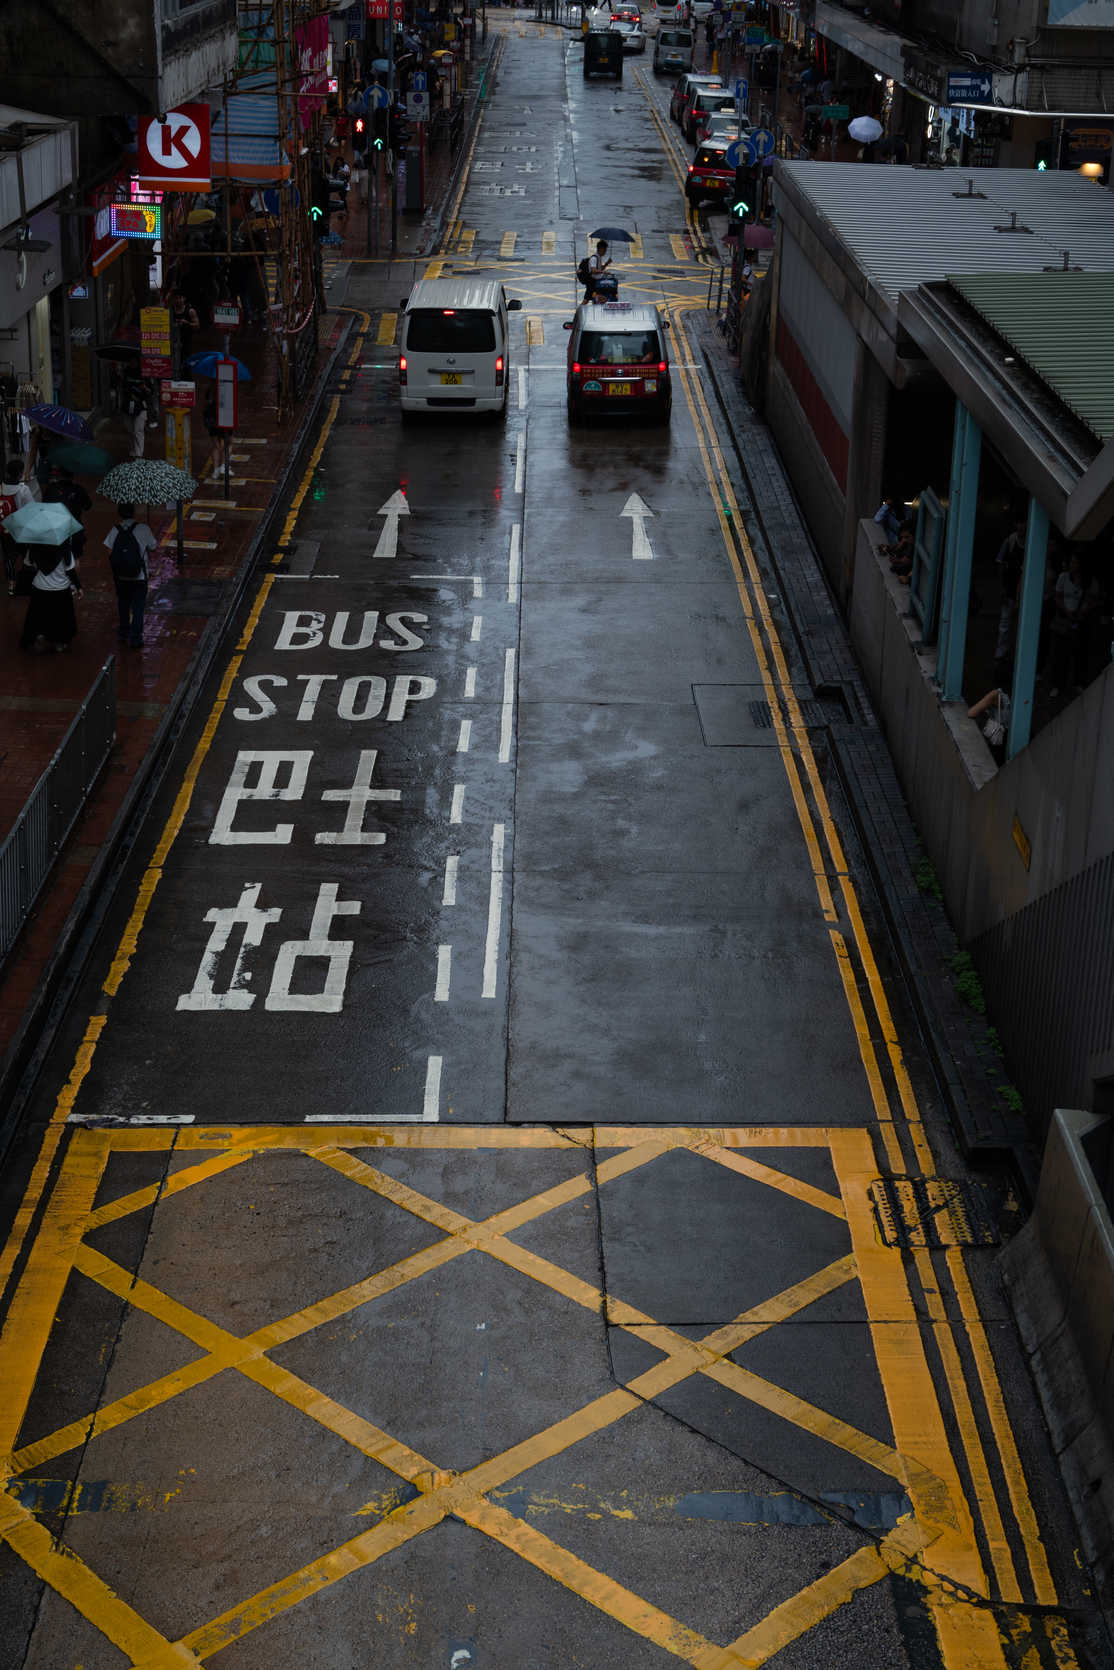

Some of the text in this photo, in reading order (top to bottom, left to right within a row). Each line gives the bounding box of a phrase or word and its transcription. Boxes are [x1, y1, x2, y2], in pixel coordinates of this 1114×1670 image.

[161, 124, 198, 167] K
[273, 610, 428, 651] BUS
[232, 674, 437, 721] STOP
[207, 749, 402, 846] 巴士
[175, 882, 362, 1013] 站
